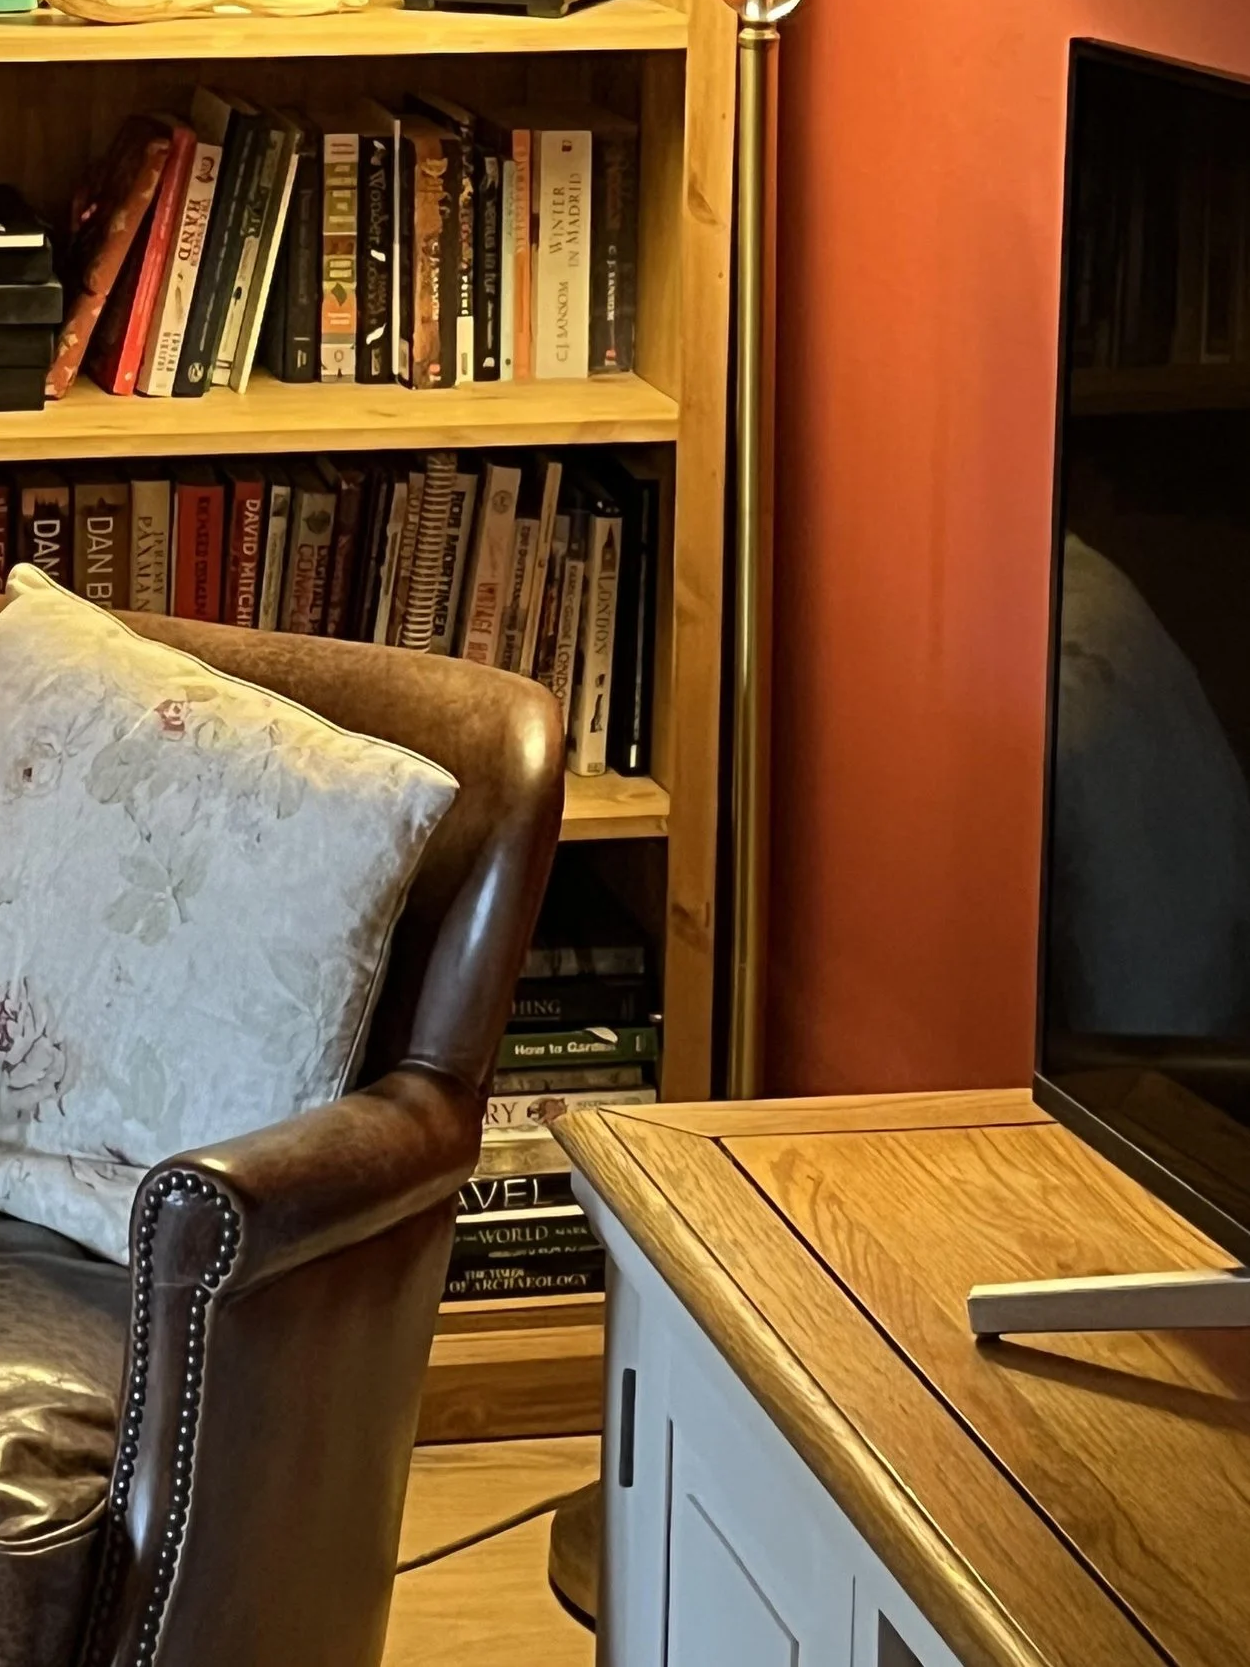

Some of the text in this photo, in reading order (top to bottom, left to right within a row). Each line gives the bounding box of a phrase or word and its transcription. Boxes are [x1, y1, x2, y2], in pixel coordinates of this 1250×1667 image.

[177, 198, 202, 261] HAND
[367, 169, 389, 243] Wonder
[548, 186, 565, 254] WINTER
[567, 172, 583, 246] MADRID
[556, 279, 570, 339] SANSOM
[605, 270, 619, 322] SANSOM
[32, 518, 61, 578] DAN
[86, 516, 114, 574] DAN
[241, 498, 262, 556] DAVID
[135, 515, 153, 612] PAXMAN
[152, 531, 165, 595] JEREMY
[432, 533, 460, 637] MORTIMER
[593, 575, 617, 656] LONDON
[514, 1043, 563, 1056] How to
[485, 1102, 527, 1126] RY
[478, 1225, 550, 1245] WORLD
[472, 1272, 588, 1291] ARCHAEOLOGY
